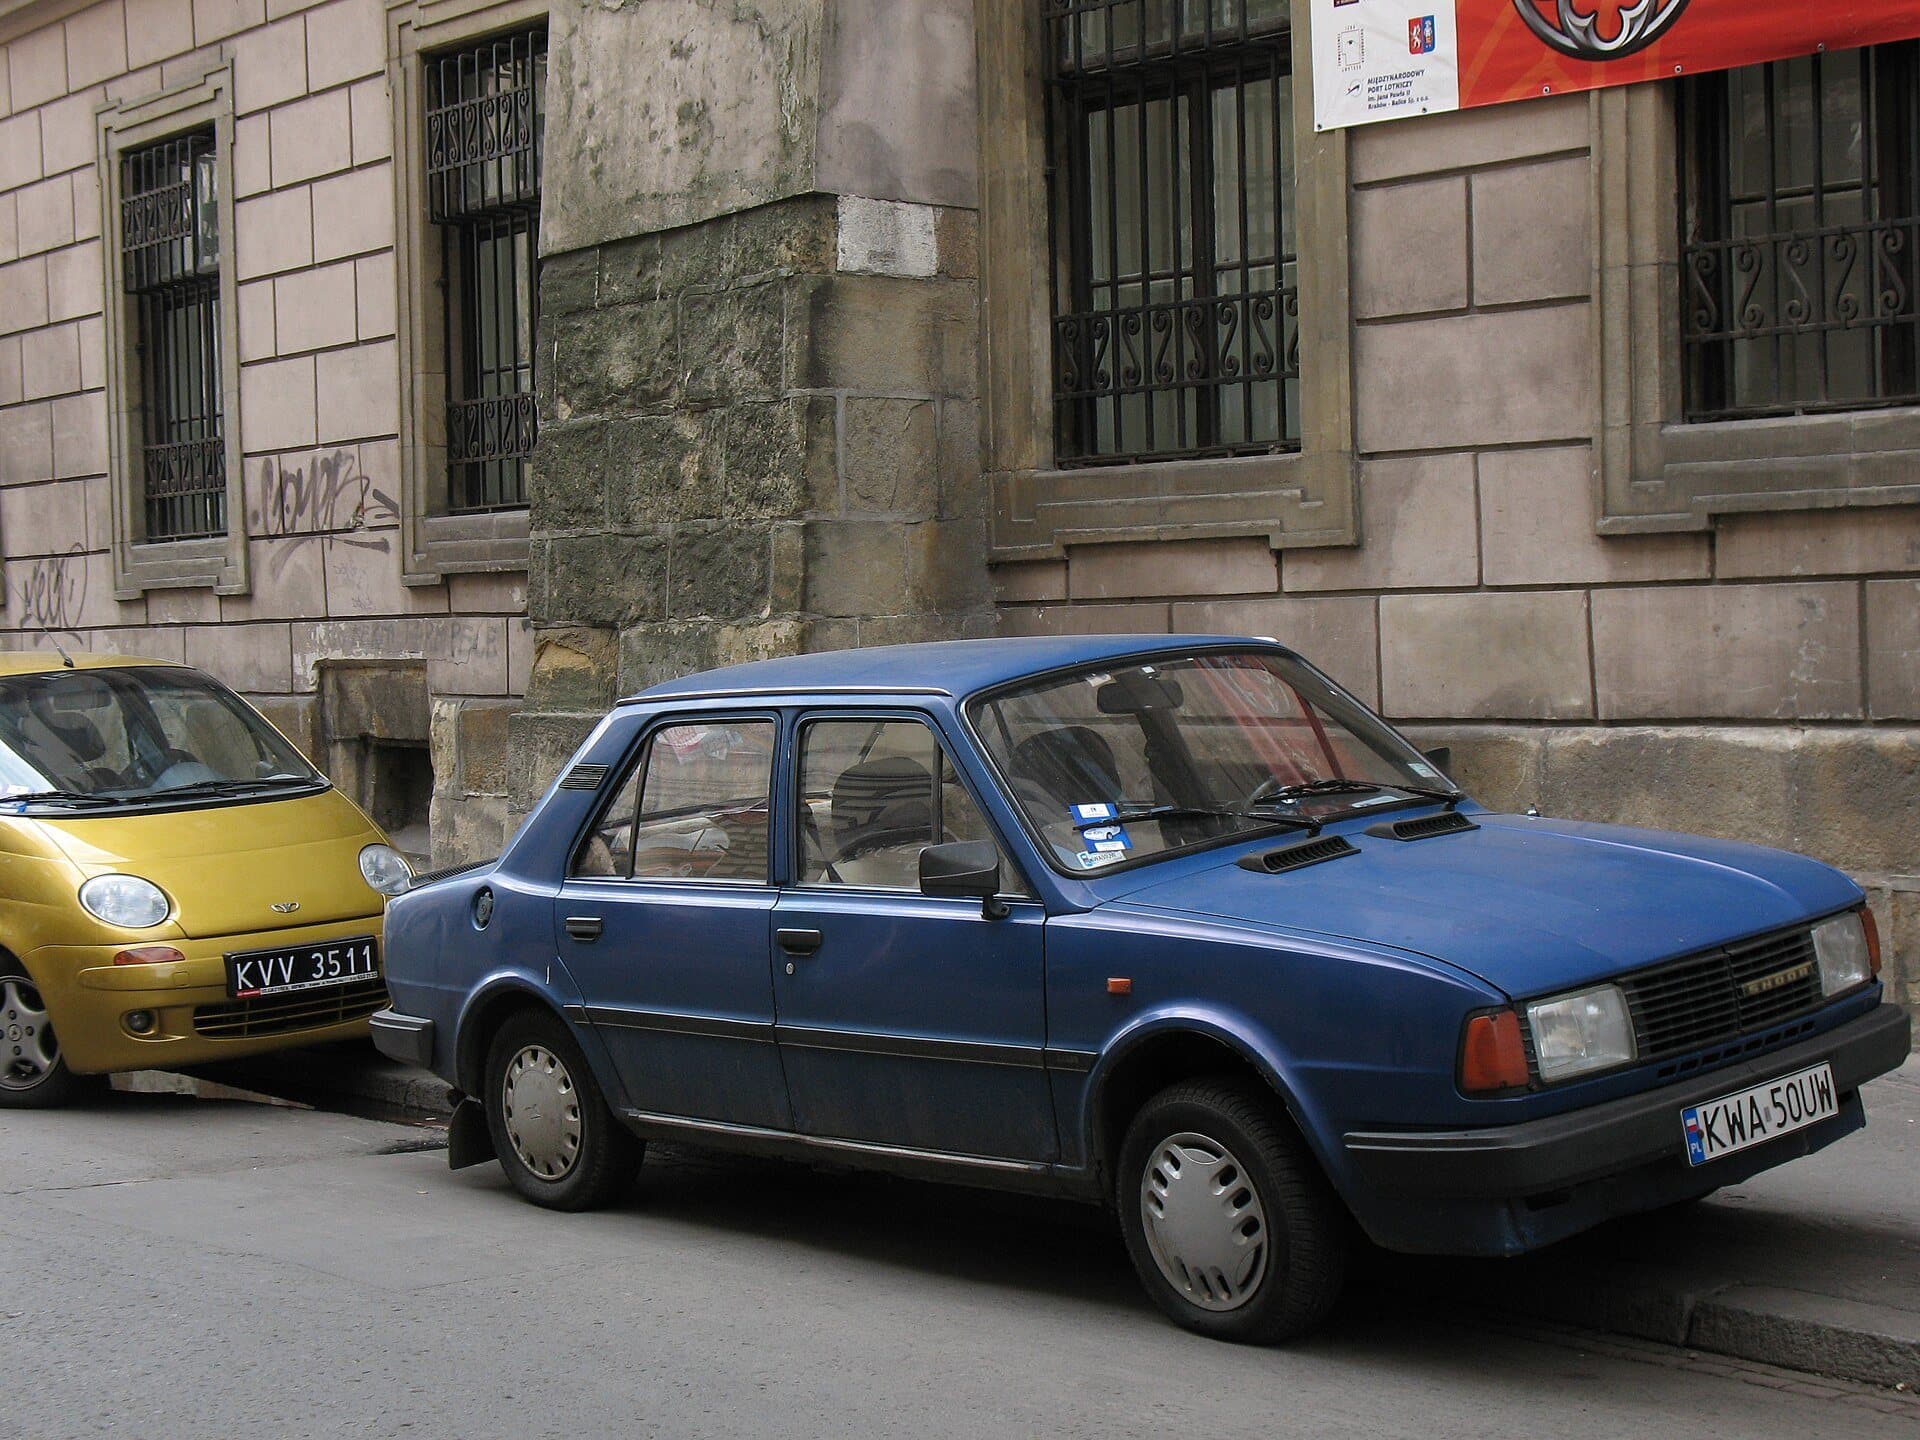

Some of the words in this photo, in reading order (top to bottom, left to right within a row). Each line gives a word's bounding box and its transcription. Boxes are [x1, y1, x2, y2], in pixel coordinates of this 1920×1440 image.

[1367, 85, 1383, 93] PORT
[1384, 80, 1413, 91] LOTNICZY
[236, 955, 295, 990] KVV
[311, 945, 372, 979] 3511
[1703, 1095, 1767, 1152] KWA
[1770, 1070, 1833, 1128] 50UW
[1690, 1142, 1702, 1154] PL
